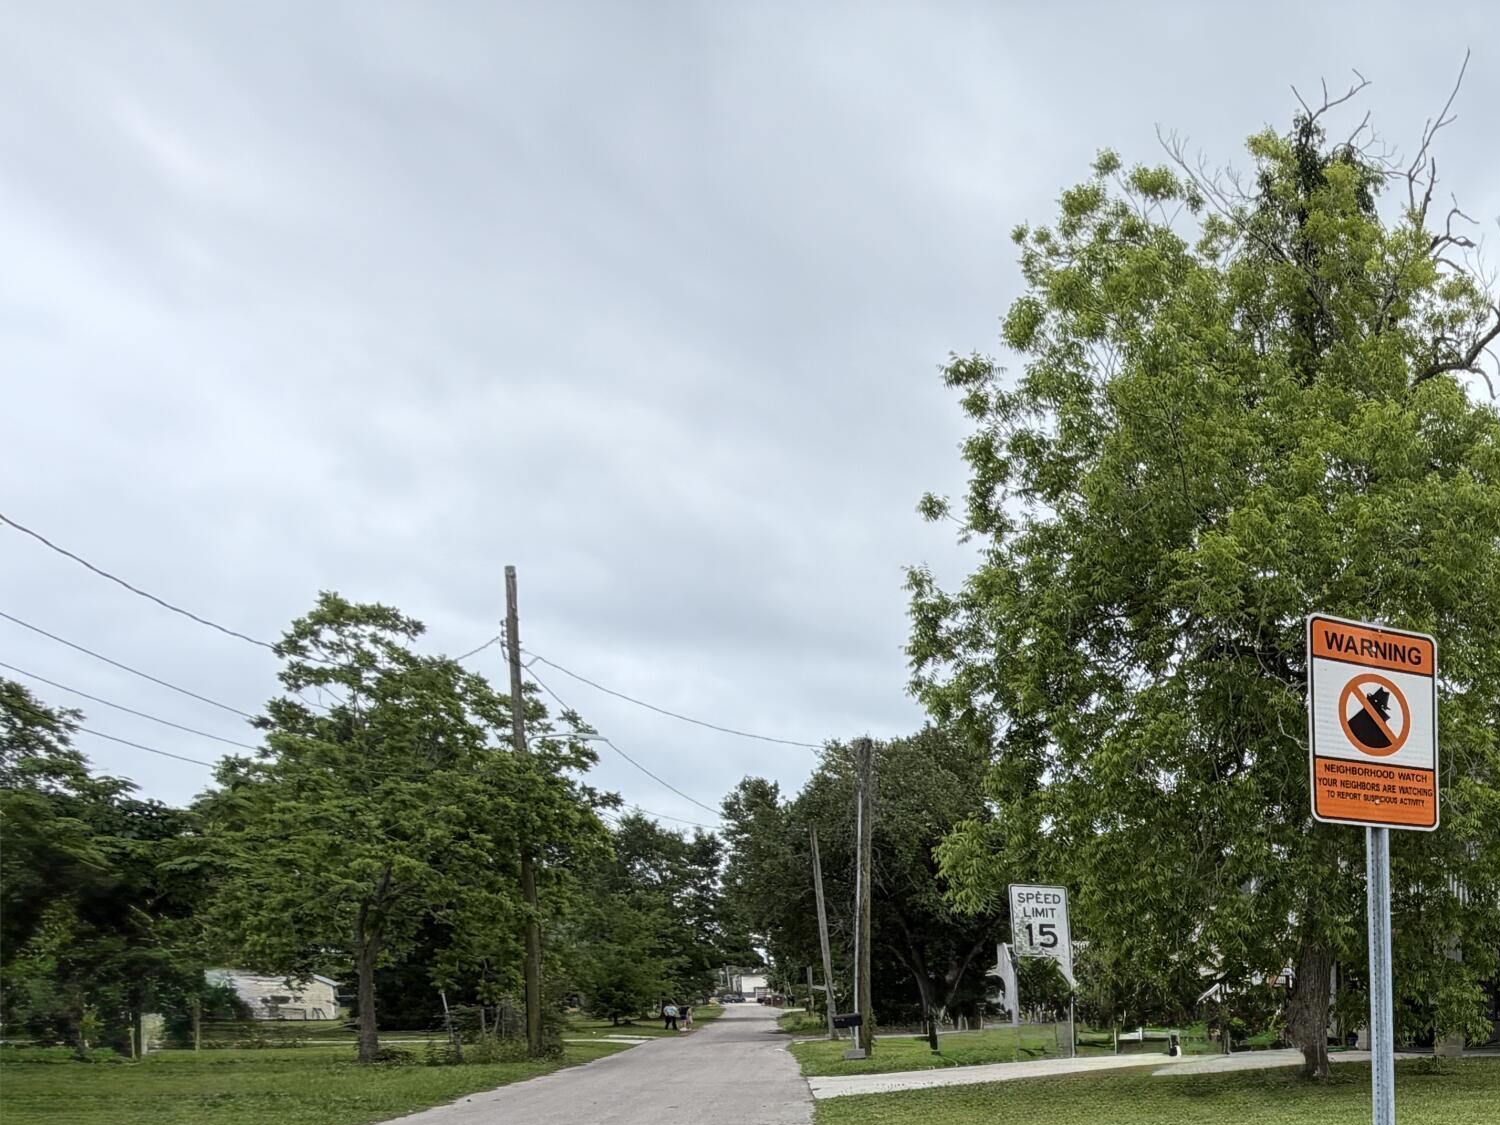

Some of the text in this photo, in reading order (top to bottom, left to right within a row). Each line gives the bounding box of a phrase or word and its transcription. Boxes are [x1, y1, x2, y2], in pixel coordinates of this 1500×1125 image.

[1324, 630, 1422, 665] WARNING
[1324, 764, 1427, 783] NEIGHBORHOOD WATCH
[1318, 777, 1433, 797] YOUR NEIGHBORS ARE WATCHING
[1327, 790, 1335, 798] TO
[1337, 792, 1360, 800] REPORT
[1400, 797, 1424, 806] ACTIVITY
[1017, 892, 1061, 904] SPEED
[1023, 907, 1056, 918] LIMIT
[1025, 923, 1058, 948] 15
